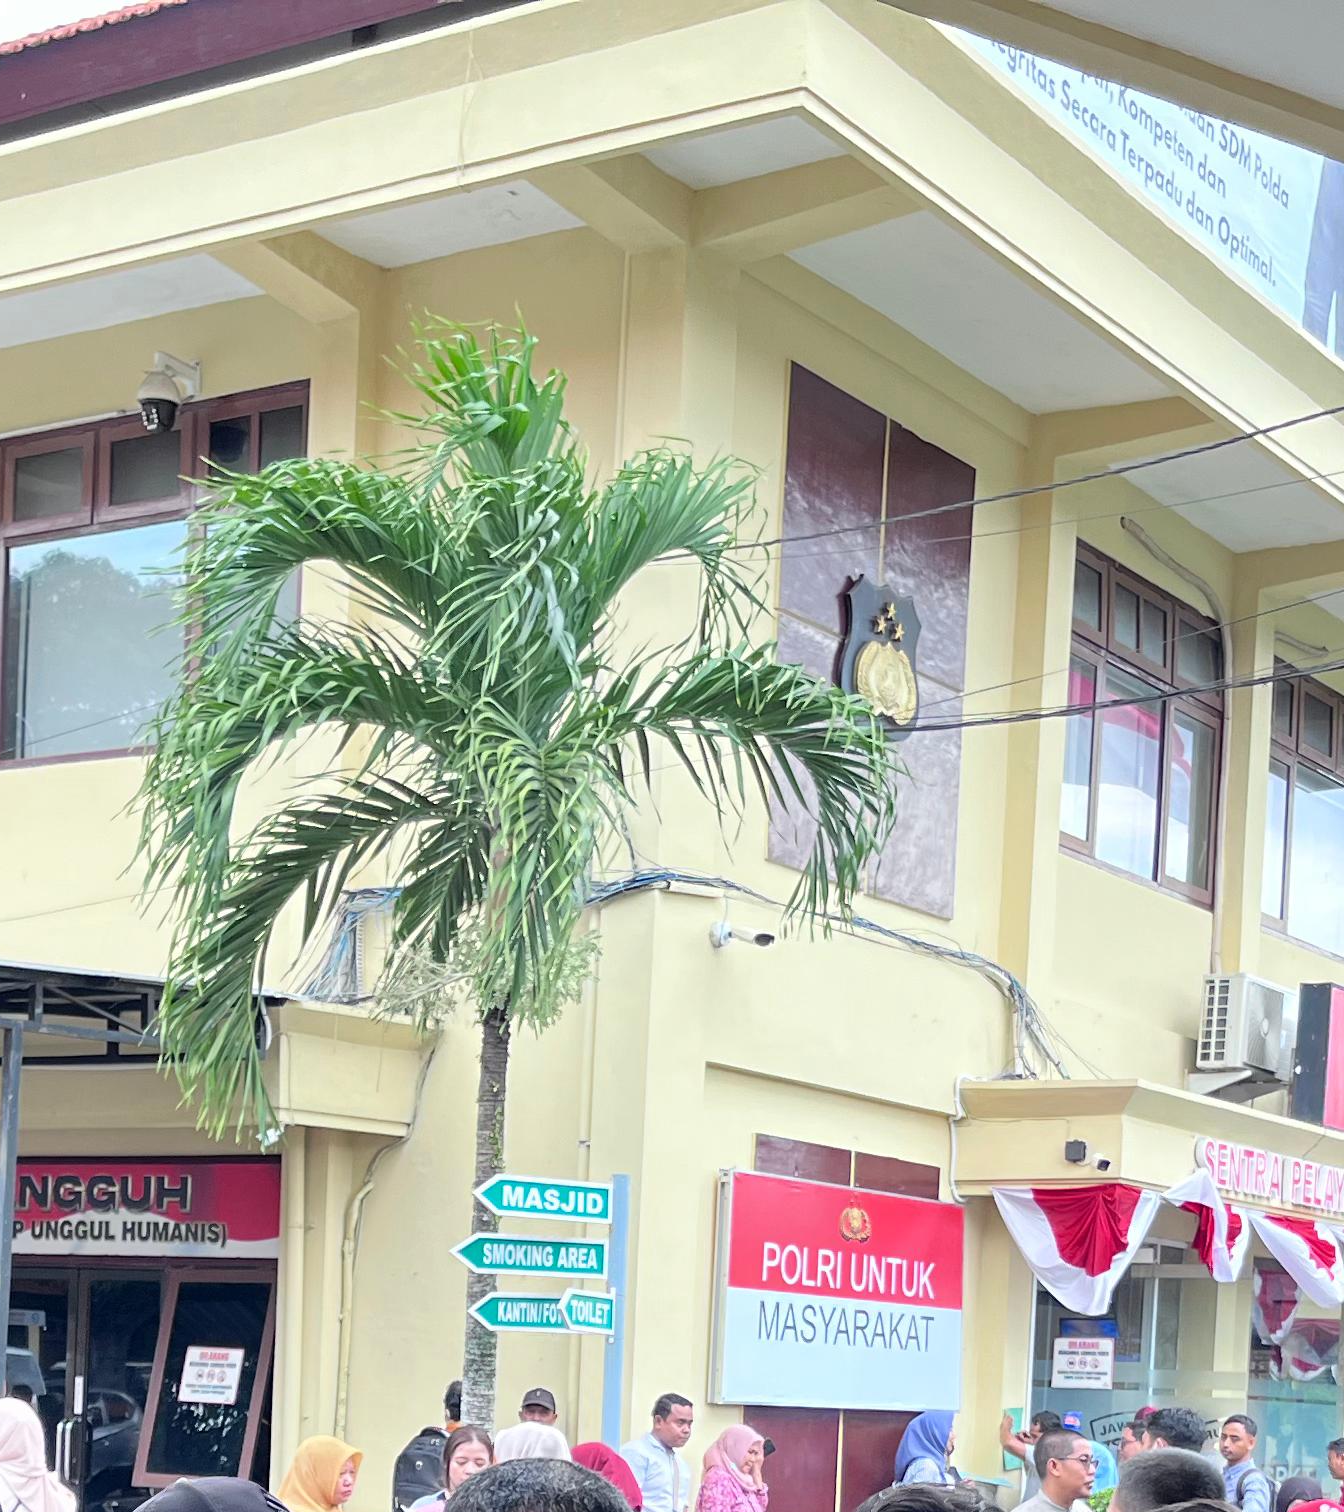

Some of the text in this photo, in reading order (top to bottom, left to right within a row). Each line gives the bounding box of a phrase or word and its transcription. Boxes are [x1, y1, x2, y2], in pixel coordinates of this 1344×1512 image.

[1118, 86, 1194, 172] Kompeten
[1198, 153, 1226, 199] dan
[1219, 123, 1250, 175] SDM
[1254, 152, 1288, 210] Polda
[1060, 79, 1117, 152] Secara
[1120, 130, 1182, 208] Terpadu
[1186, 191, 1214, 234] dan
[1218, 216, 1277, 287] Optimal.
[1204, 1140, 1282, 1199] SENTRA
[502, 1184, 604, 1215] MASJID
[31, 1219, 116, 1242] UNGGUL
[122, 1221, 228, 1248] HUMANIS)
[483, 1243, 598, 1269] SMOKING AREA
[761, 1242, 936, 1300] POLRI UNTUK
[570, 1299, 611, 1325] TOILET
[758, 1300, 935, 1353] MASYARAKAT
